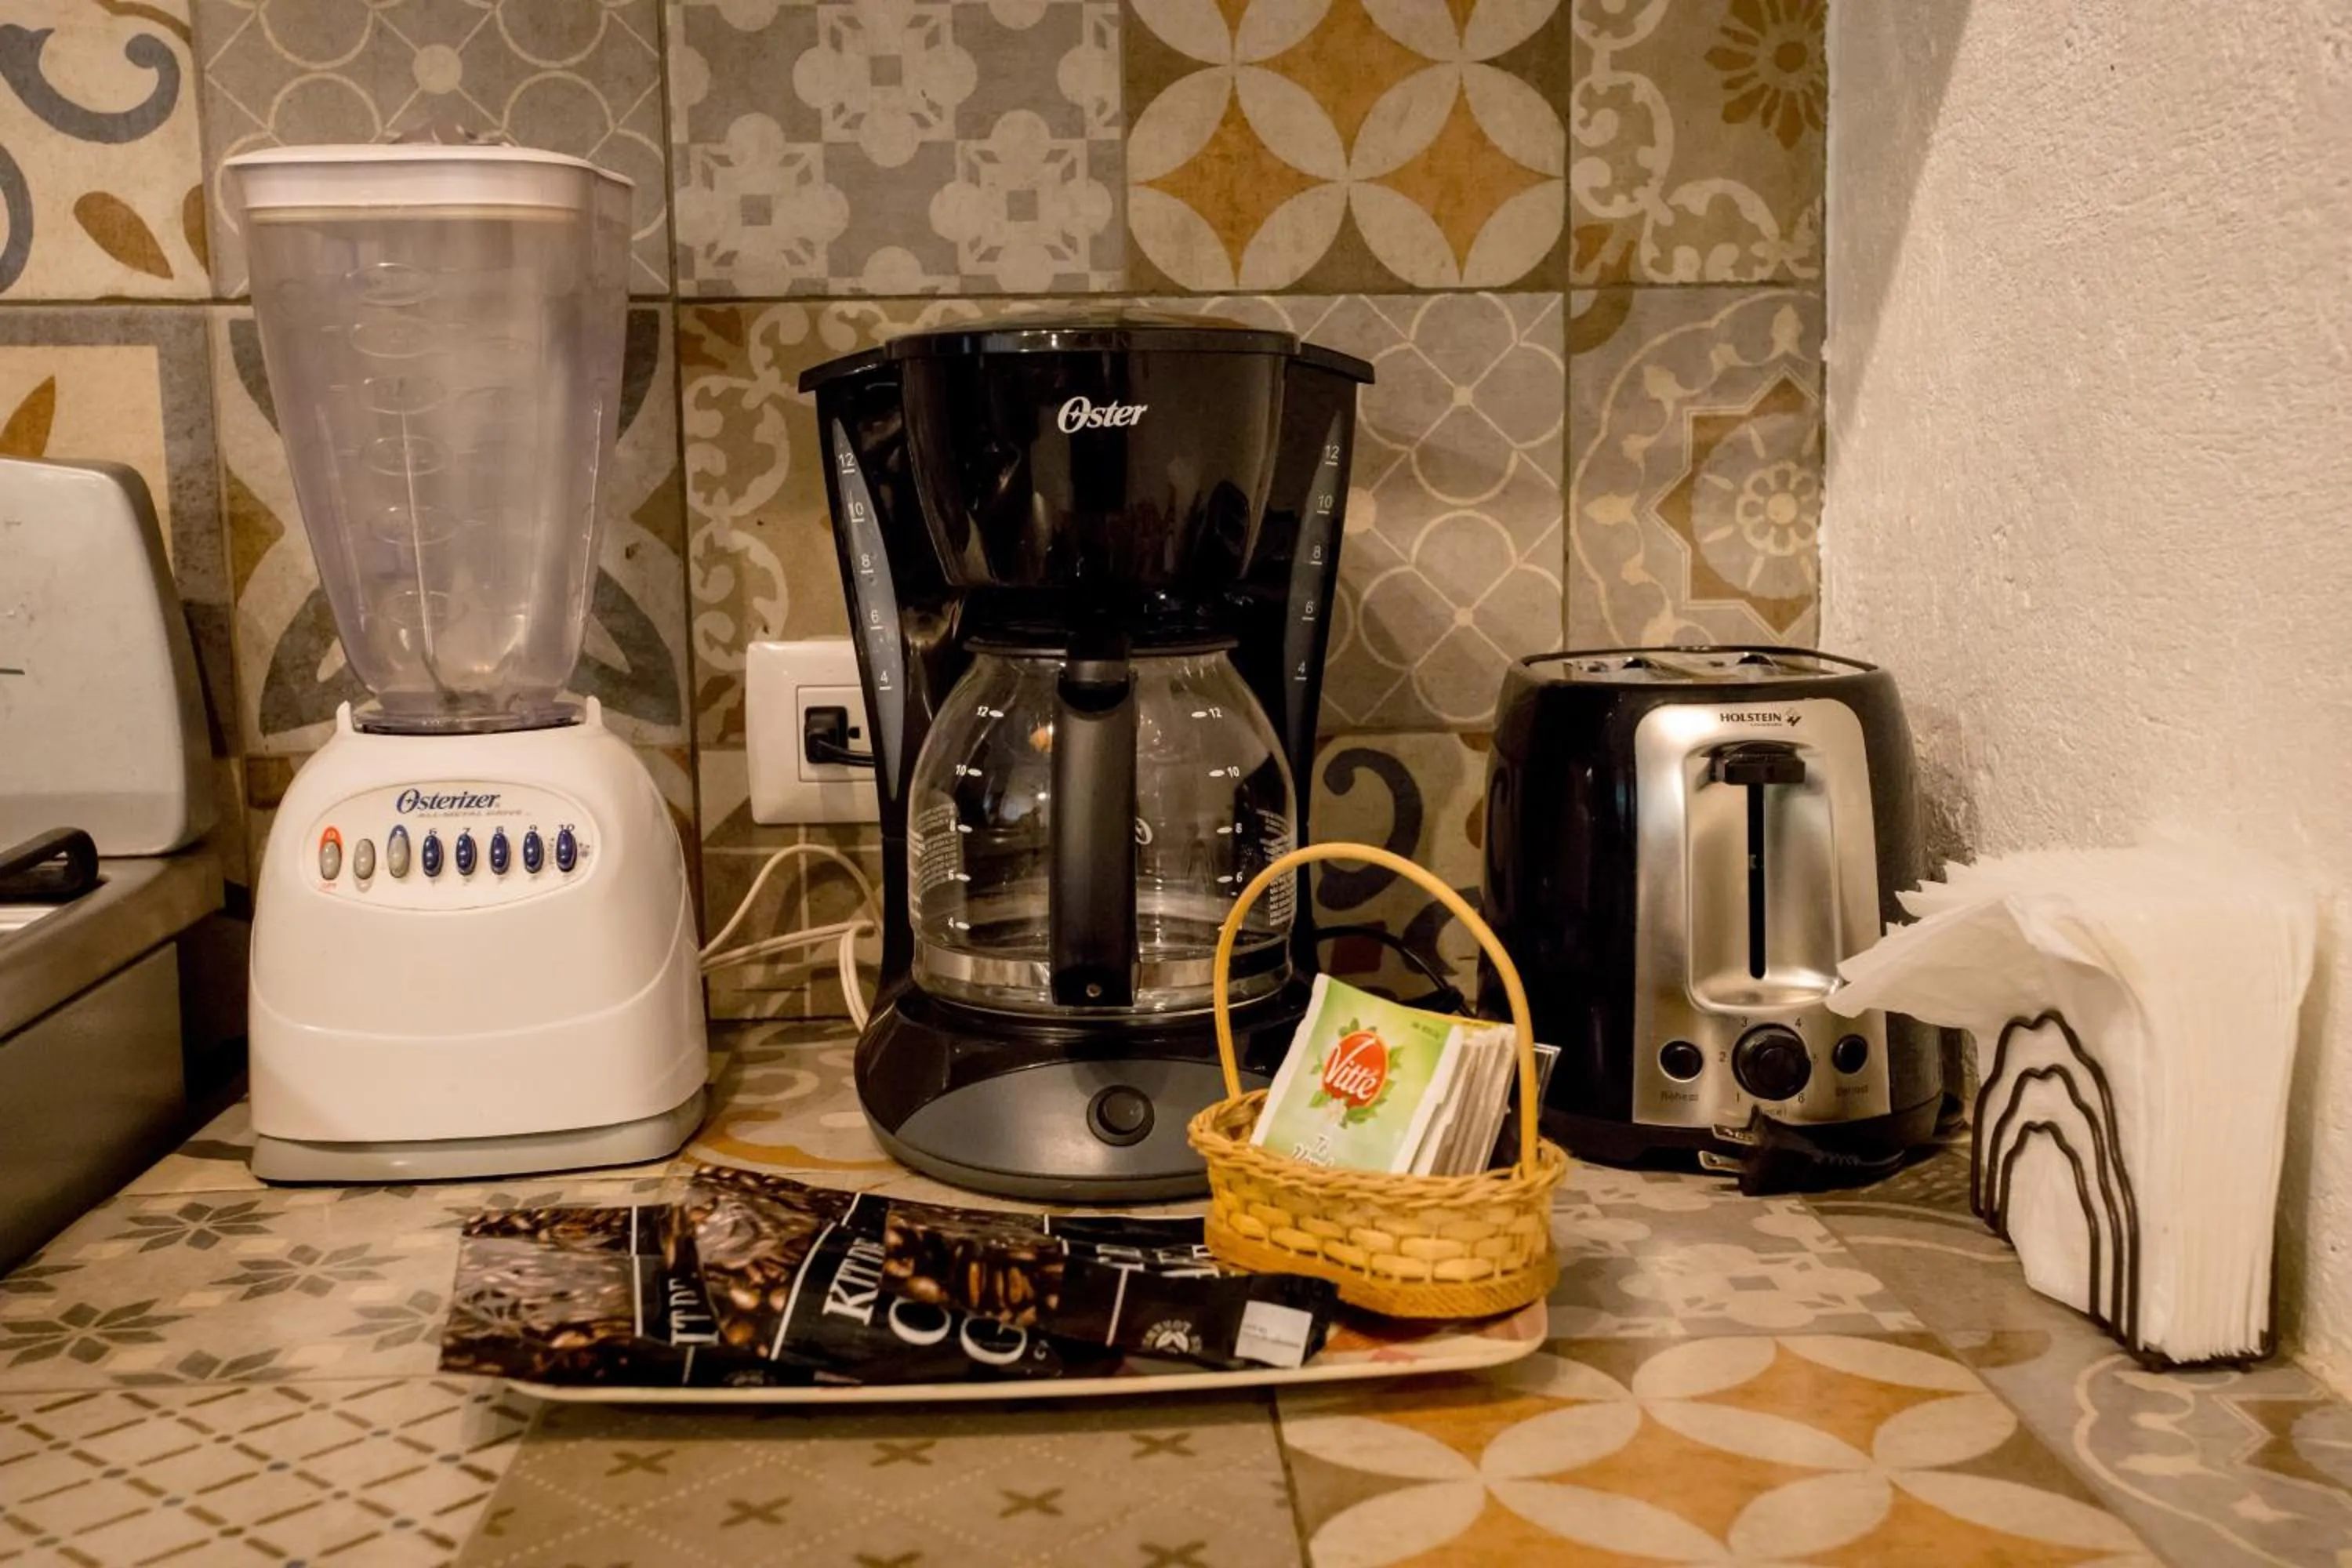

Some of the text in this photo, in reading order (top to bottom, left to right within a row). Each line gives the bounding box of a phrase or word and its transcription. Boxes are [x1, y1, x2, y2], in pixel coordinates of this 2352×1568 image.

[1058, 396, 1148, 434] Oster
[1325, 445, 1340, 459] 12
[838, 452, 855, 466] 12
[1318, 495, 1333, 510] 10
[848, 502, 863, 518] 10
[1312, 546, 1321, 559] 8
[862, 554, 869, 568] 8
[1305, 601, 1313, 614] 6
[870, 609, 879, 623] 6
[1298, 662, 1306, 673] 4
[880, 670, 889, 684] 4
[977, 706, 989, 717] 12
[1208, 707, 1222, 719] 12
[1719, 713, 1782, 722] HOLSTEIN
[956, 764, 967, 776] 10
[1227, 766, 1240, 778] 10
[396, 788, 501, 814] Osterizer
[1236, 871, 1243, 883] 6
[948, 916, 954, 928] 4
[1741, 1016, 1748, 1027] 3
[1795, 1018, 1802, 1027] 4
[1719, 1051, 1726, 1062] 2
[1798, 1093, 1805, 1103] 6
[822, 1258, 883, 1326] KIT
[670, 1309, 720, 1346] IT
